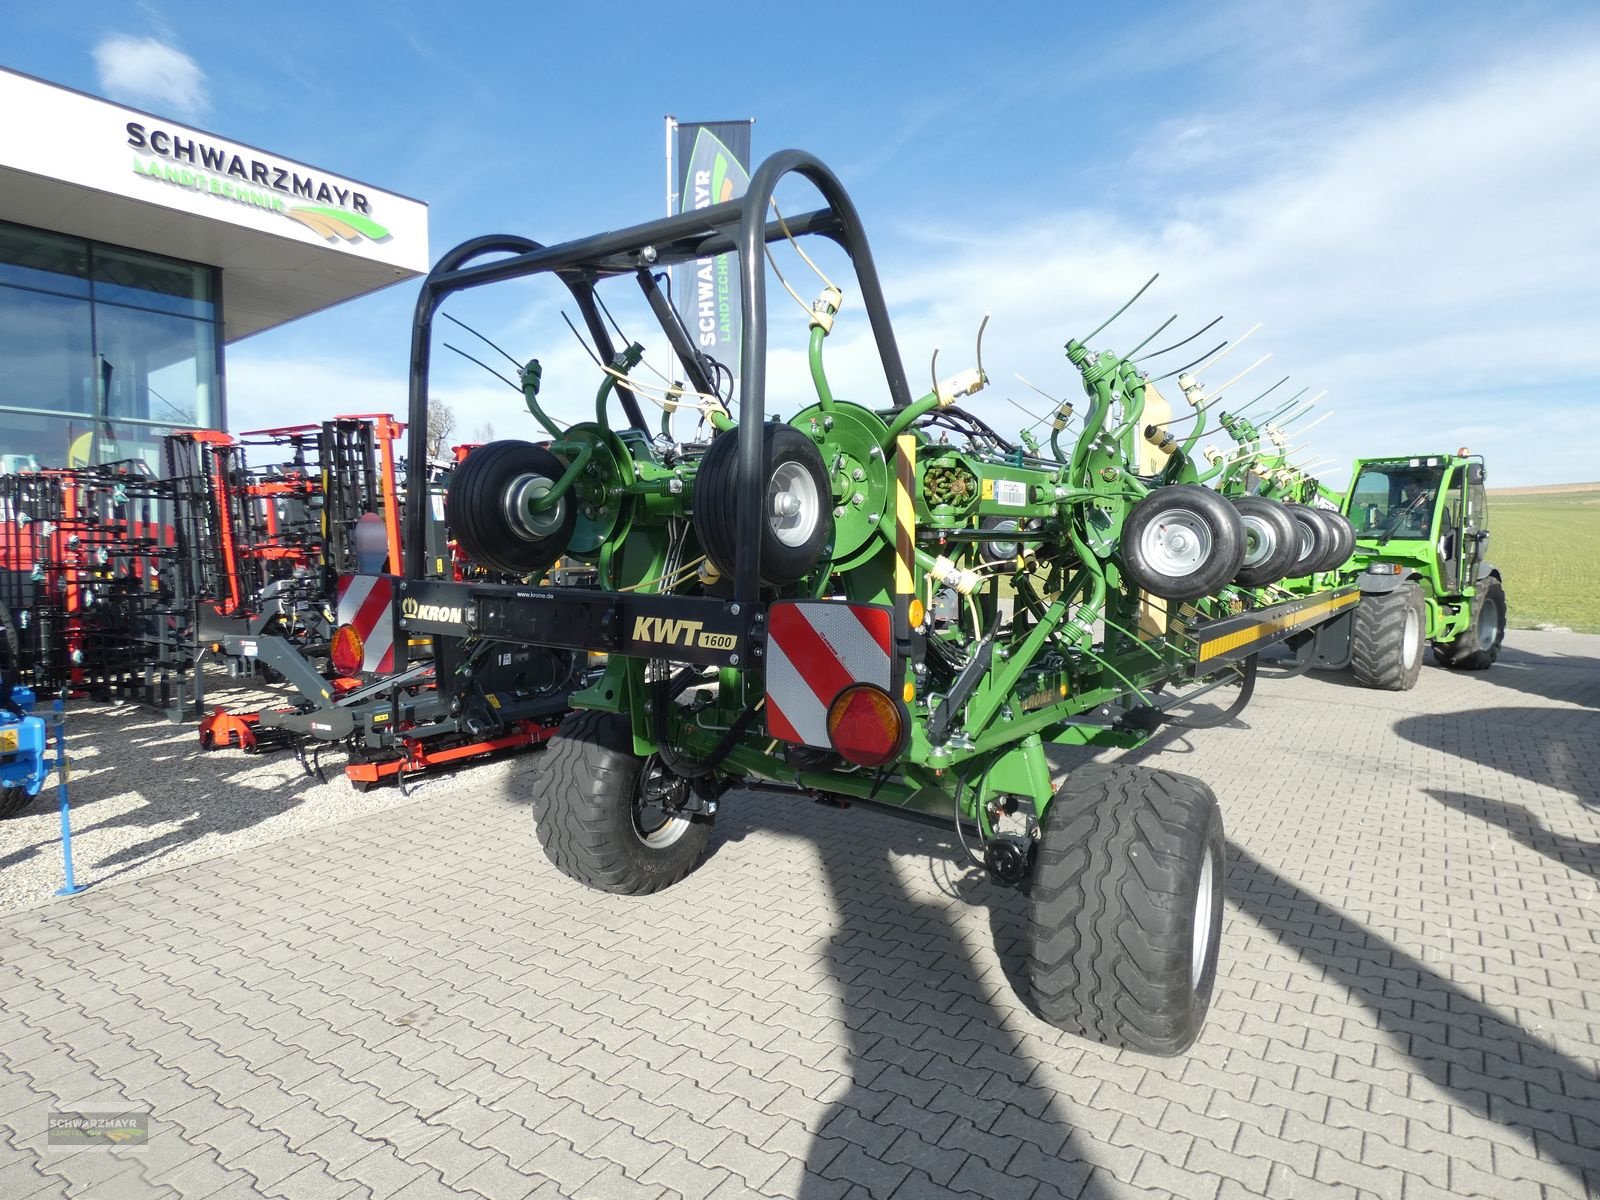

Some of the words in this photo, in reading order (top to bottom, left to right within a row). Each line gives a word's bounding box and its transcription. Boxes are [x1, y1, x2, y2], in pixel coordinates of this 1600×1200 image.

[126, 122, 369, 214] SCHWARZMAYR
[133, 155, 285, 213] LANDTECHNIK
[717, 253, 732, 342] LANDTECHN
[516, 591, 554, 600] www.krone.de
[417, 604, 463, 624] KRON
[631, 615, 704, 647] KWT
[704, 635, 732, 648] 1600
